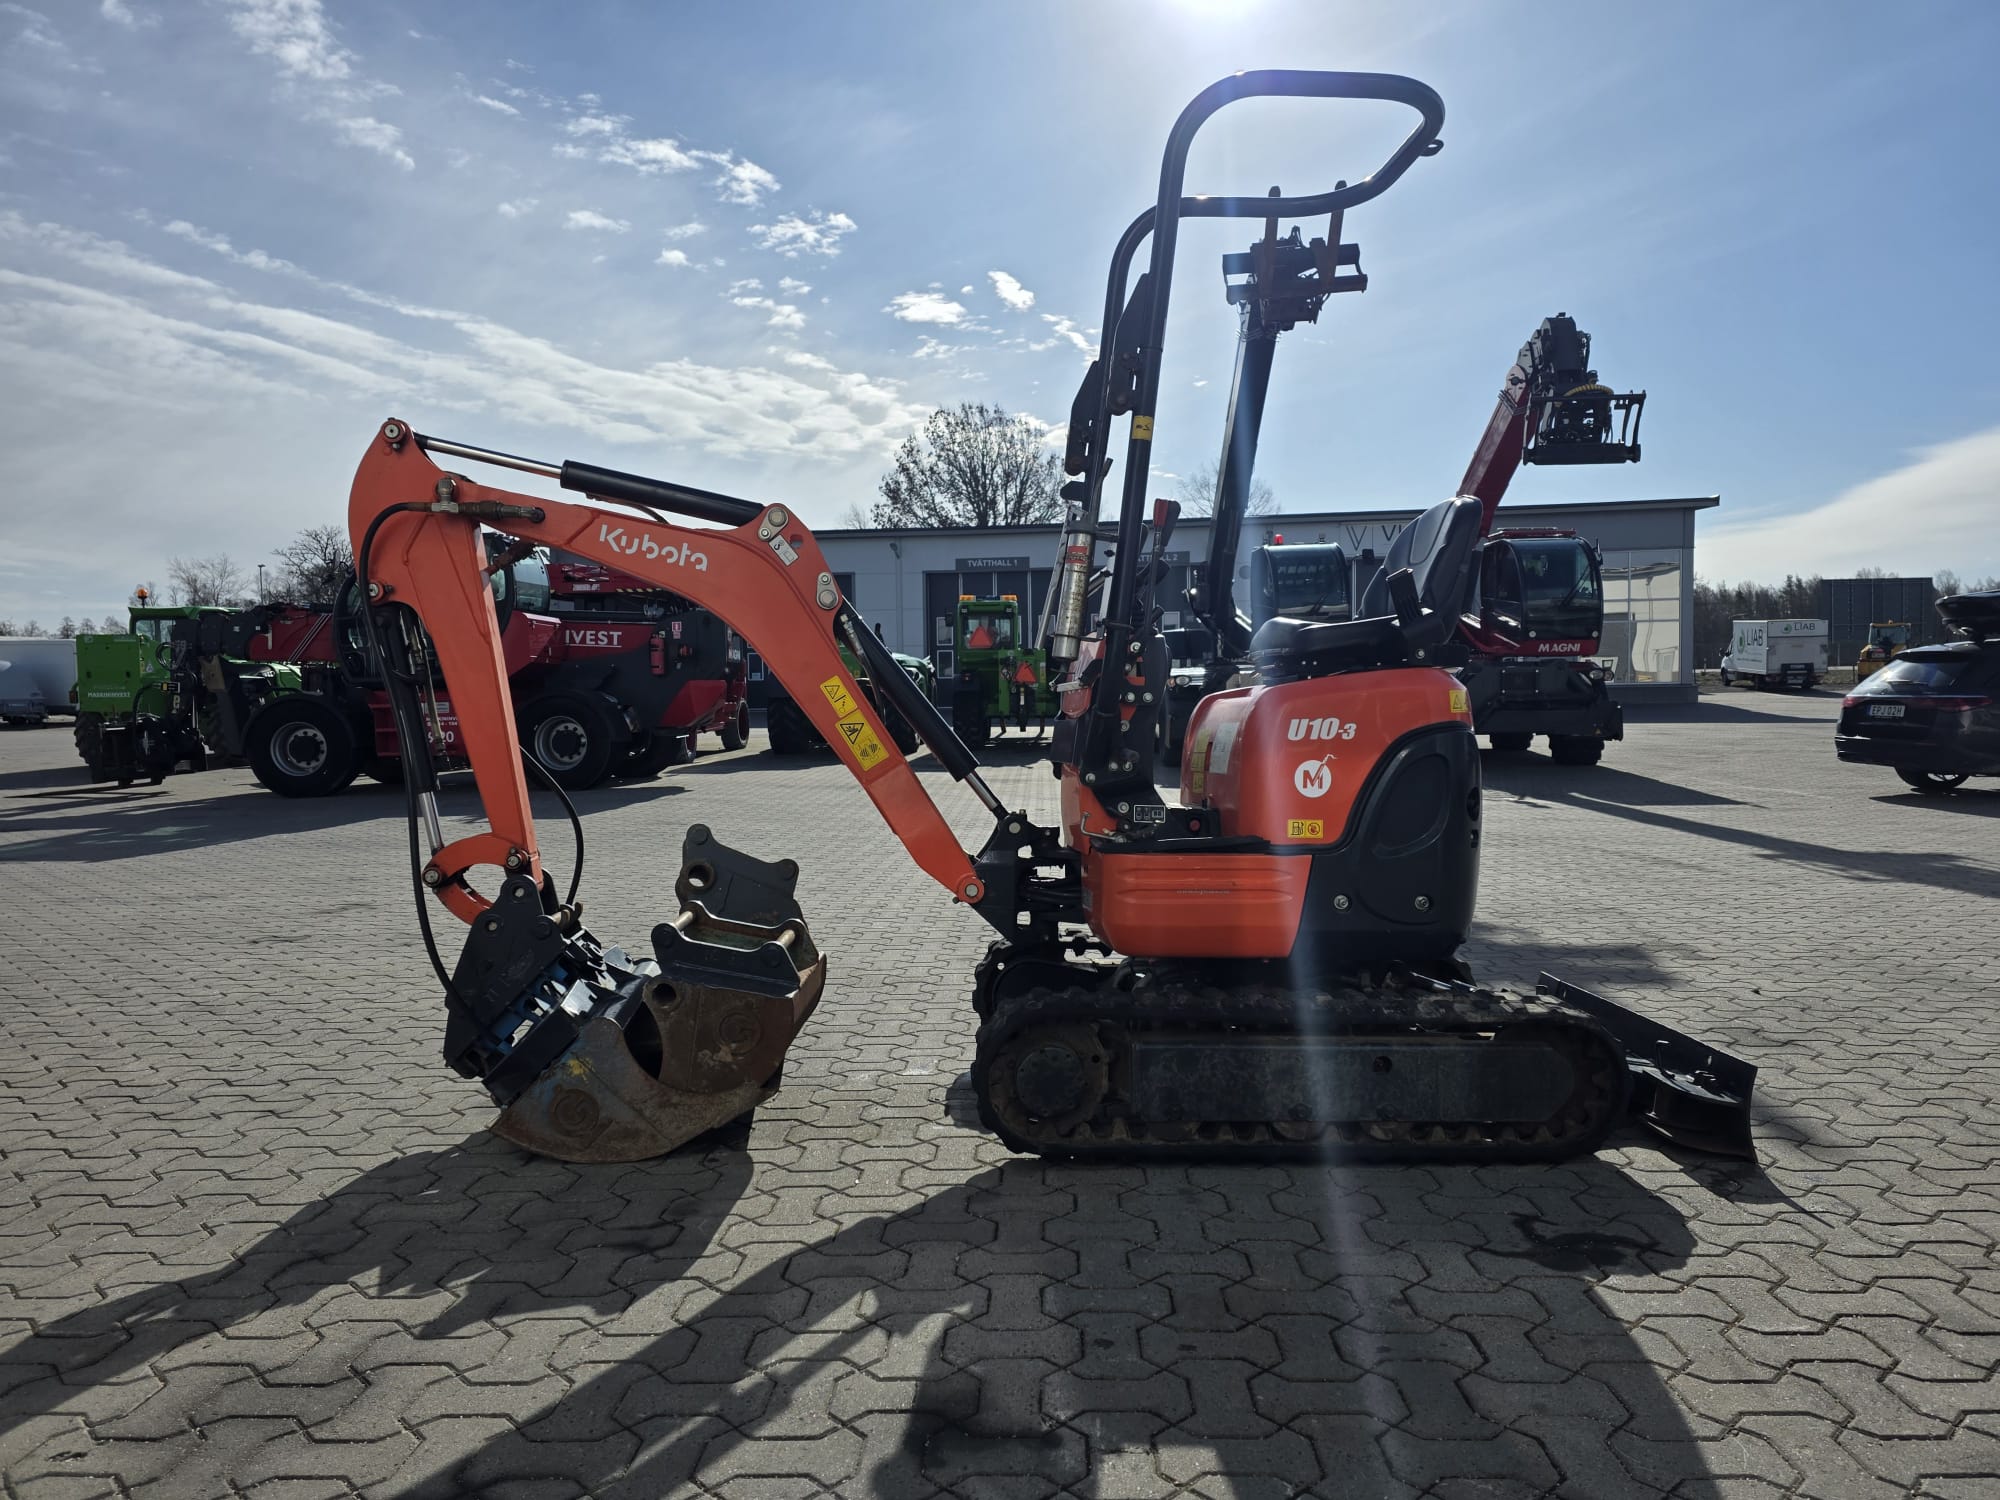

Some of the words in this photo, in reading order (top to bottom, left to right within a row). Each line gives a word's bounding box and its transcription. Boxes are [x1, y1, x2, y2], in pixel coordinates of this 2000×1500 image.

[599, 524, 708, 572] Kubota
[1794, 622, 1816, 631] LIAB
[1746, 627, 1764, 647] LIAB
[1538, 643, 1581, 652] MAGNI
[1287, 717, 1357, 741] U10-3
